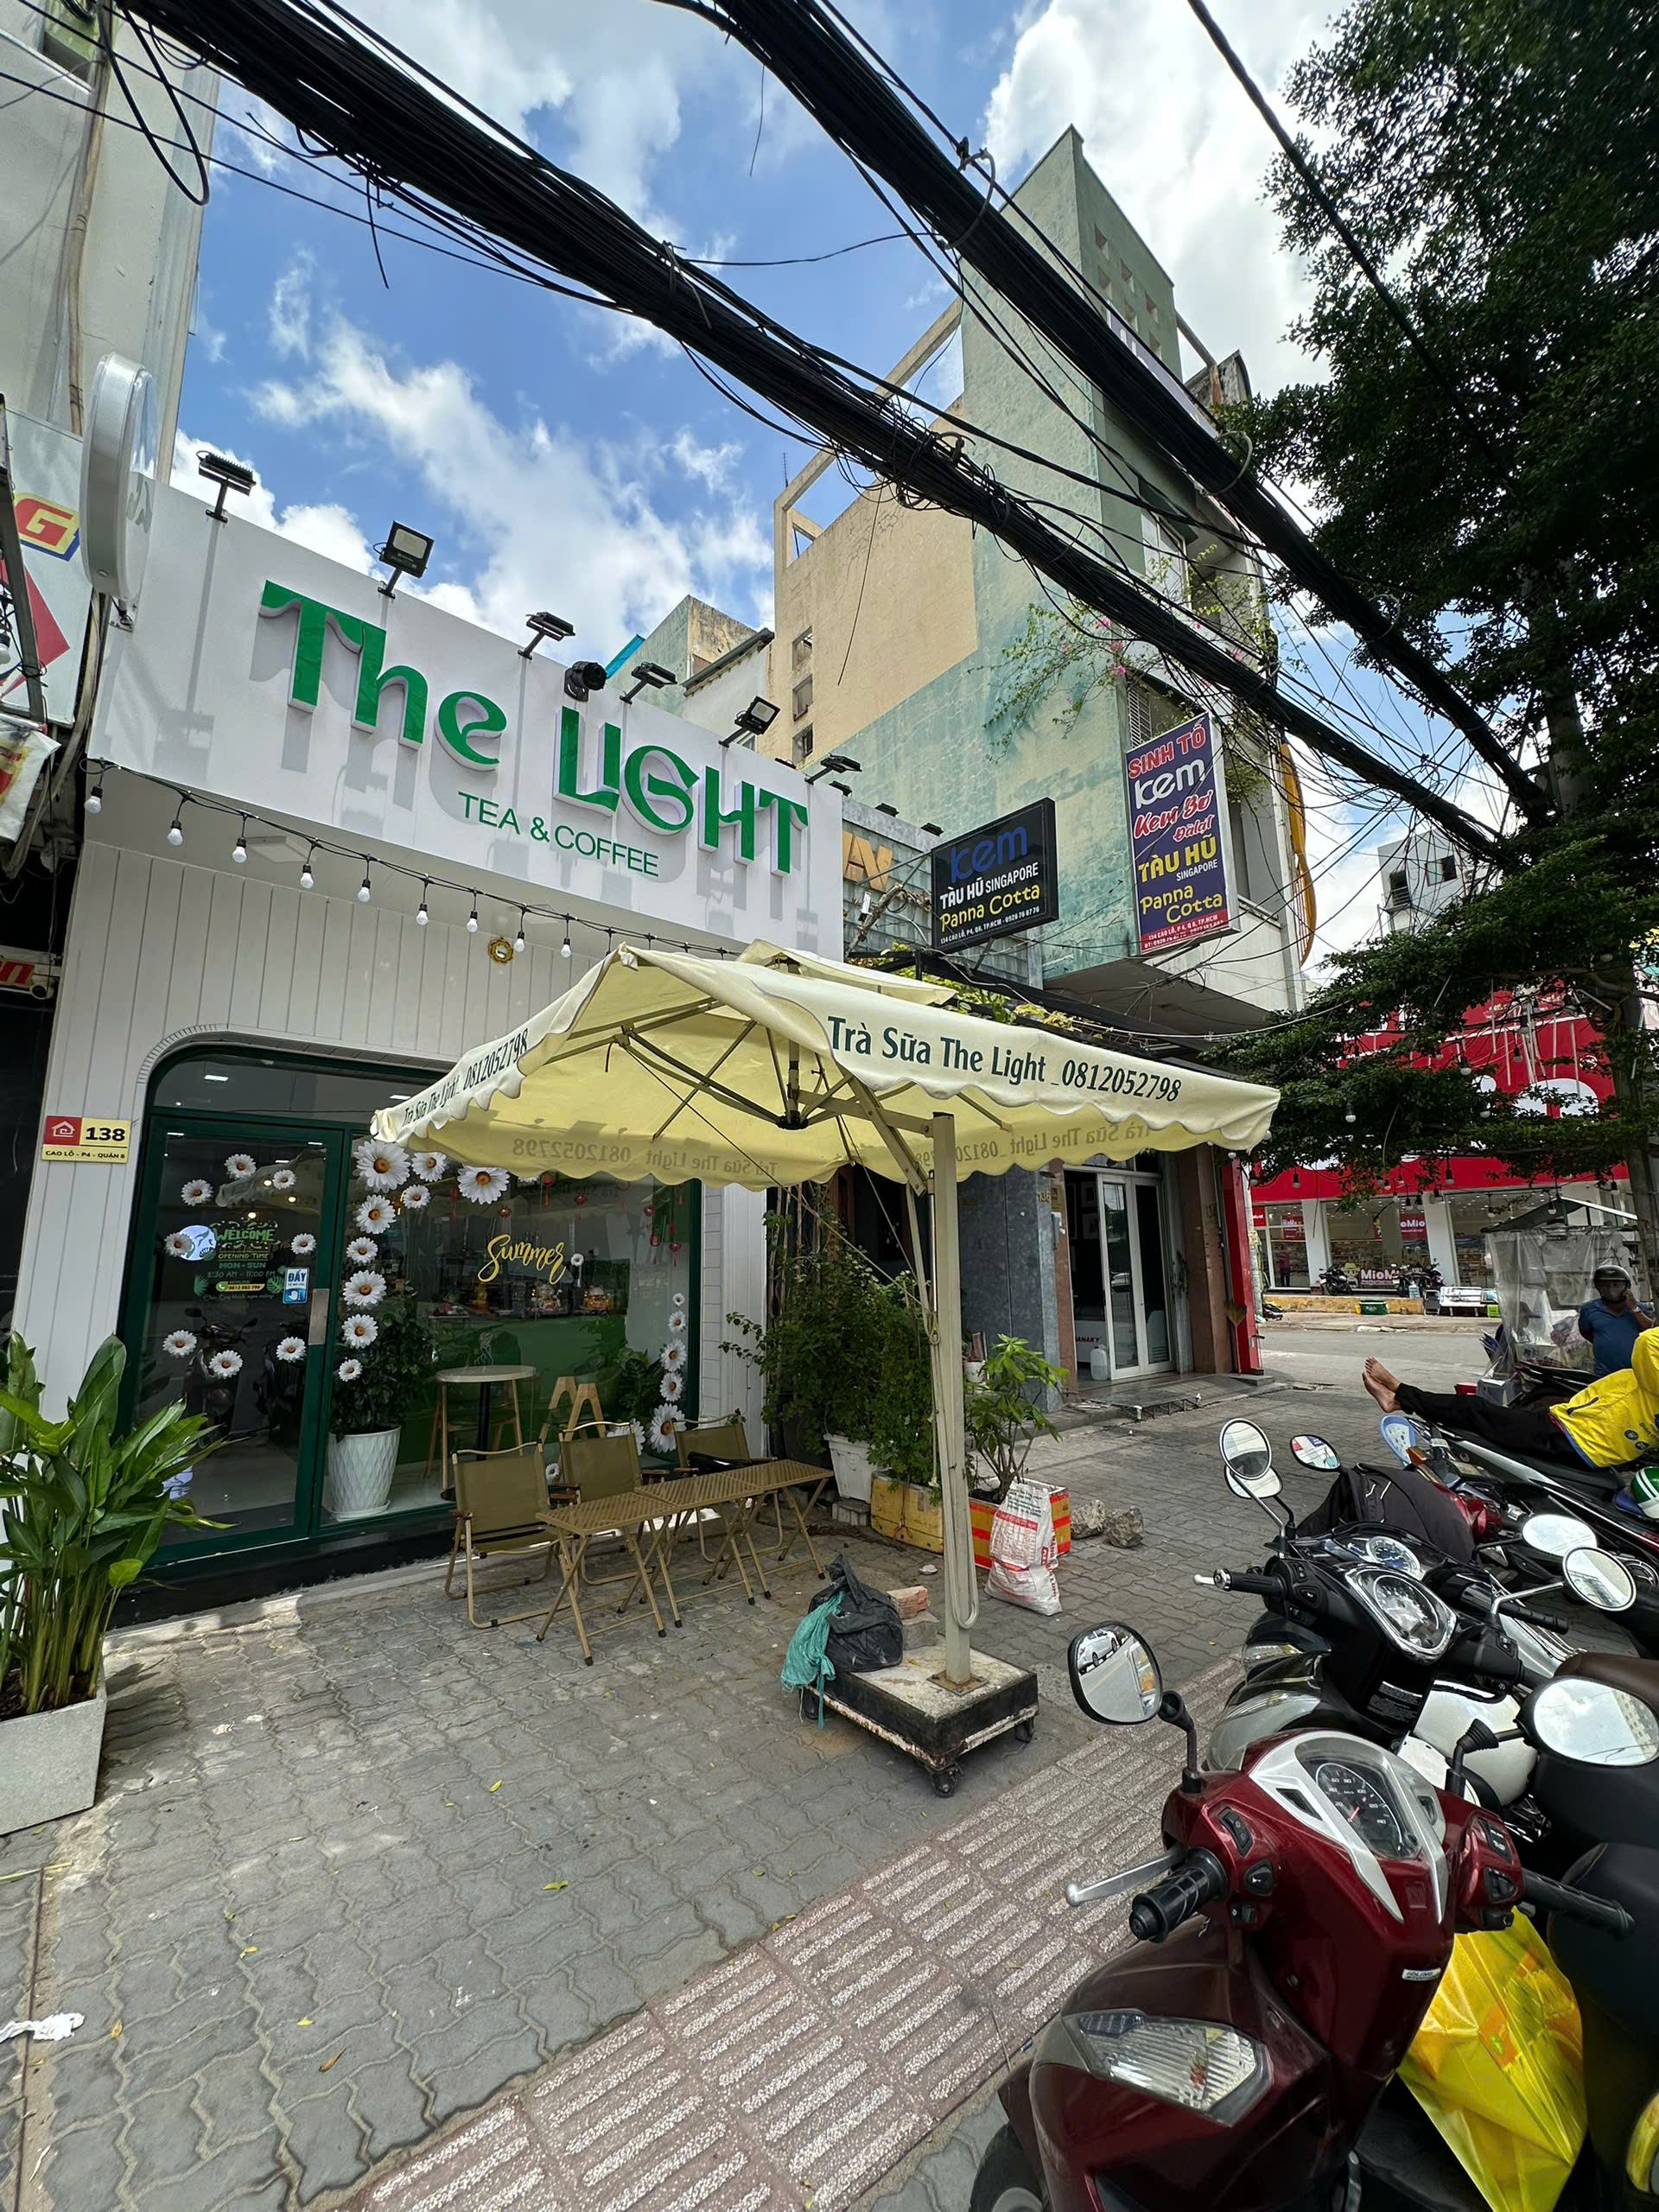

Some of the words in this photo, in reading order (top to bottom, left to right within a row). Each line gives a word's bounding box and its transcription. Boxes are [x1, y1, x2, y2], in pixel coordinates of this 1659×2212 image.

[259, 580, 507, 769] The
[554, 705, 809, 875] LIGHT
[1128, 741, 1175, 779] SINH
[1176, 716, 1206, 755] TỐ
[458, 791, 520, 836] TEA
[530, 817, 550, 843] &
[554, 824, 659, 878] COFFEE
[1134, 806, 1179, 839] Kem
[1138, 853, 1179, 883] TÀU
[1185, 833, 1217, 867] HŨ
[1176, 858, 1218, 881] SINGAPORE
[939, 886, 964, 910] TÀU
[985, 861, 1039, 893] SINGAPORE
[939, 904, 985, 933] Panna
[989, 884, 1040, 915] Cotta
[1140, 885, 1193, 915] Panna
[1166, 893, 1223, 924] Cotta
[827, 1015, 872, 1055] Trà
[881, 1026, 931, 1065] Sữa
[940, 1036, 983, 1072] The
[992, 1046, 1046, 1085] Light
[85, 1127, 125, 1141] 138
[213, 1226, 276, 1242] WELCOME
[477, 1234, 567, 1285] Summer
